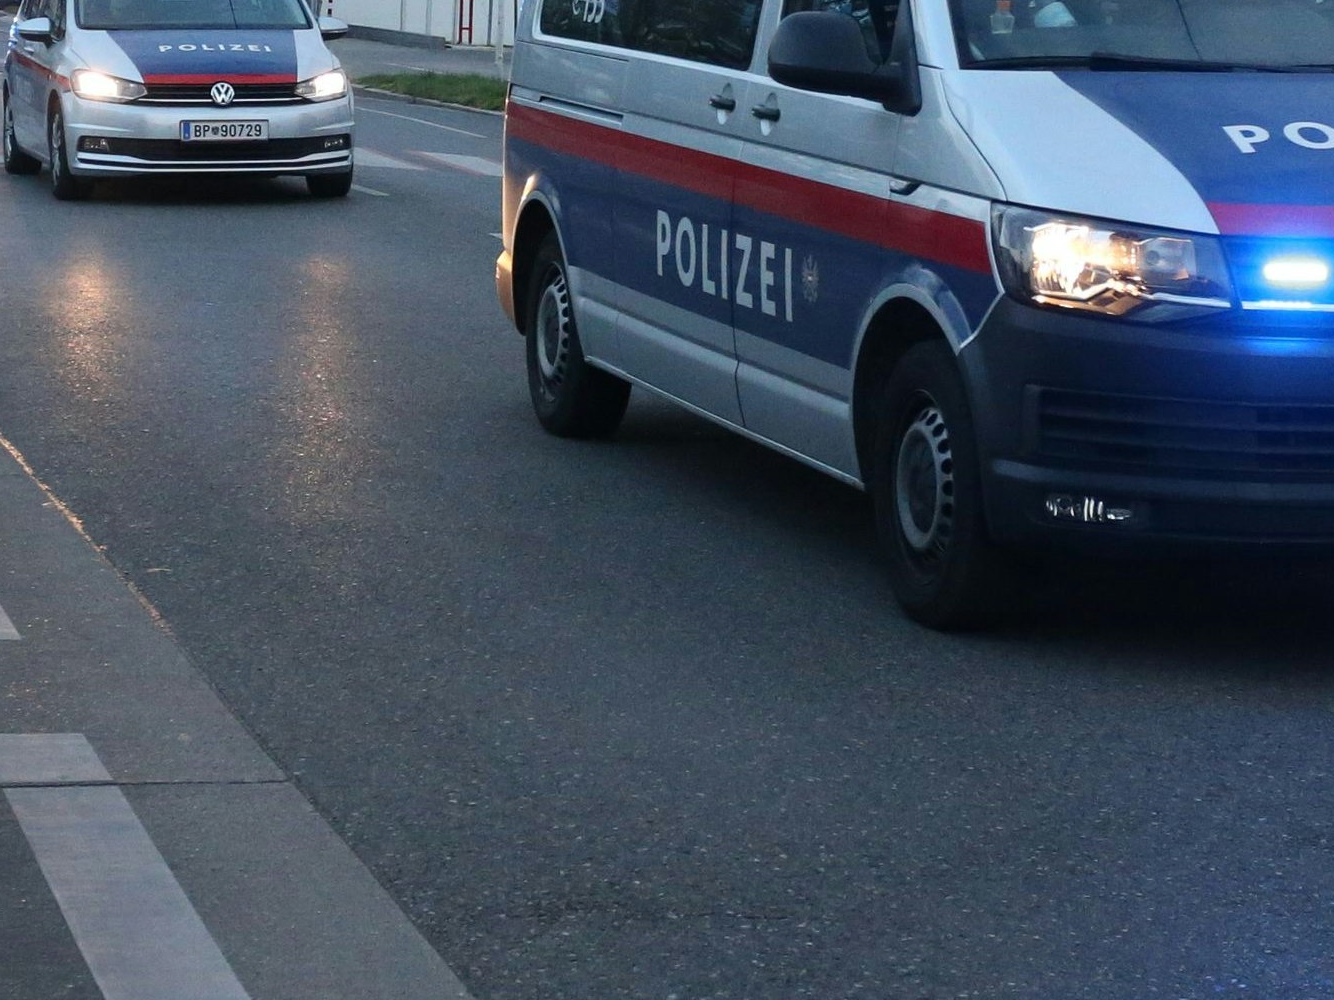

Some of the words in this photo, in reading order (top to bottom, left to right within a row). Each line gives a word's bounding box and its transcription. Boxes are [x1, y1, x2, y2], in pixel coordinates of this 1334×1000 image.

[158, 43, 272, 53] POLIZEI
[193, 123, 210, 138] BP
[220, 123, 262, 138] 90729
[656, 208, 793, 323] POLIZEI
